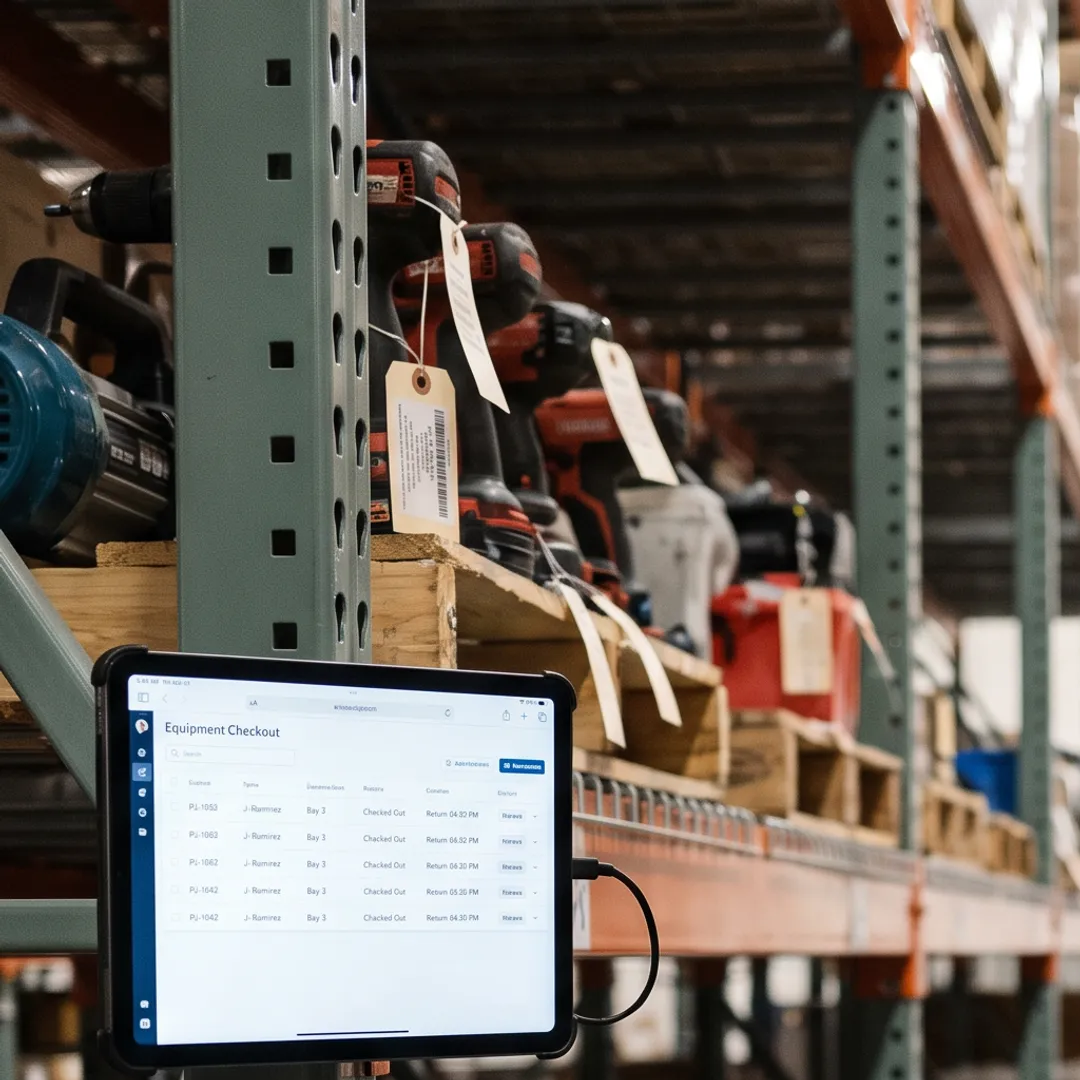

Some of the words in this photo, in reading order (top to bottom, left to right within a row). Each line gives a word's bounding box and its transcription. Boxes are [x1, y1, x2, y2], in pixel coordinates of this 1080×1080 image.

[165, 722, 225, 736] Equipment
[228, 725, 280, 738] Checkout
[306, 807, 319, 816] Bay
[306, 834, 319, 842] Bay
[306, 860, 319, 869] Bay
[306, 887, 319, 896] Bay
[307, 914, 319, 923] Bay
